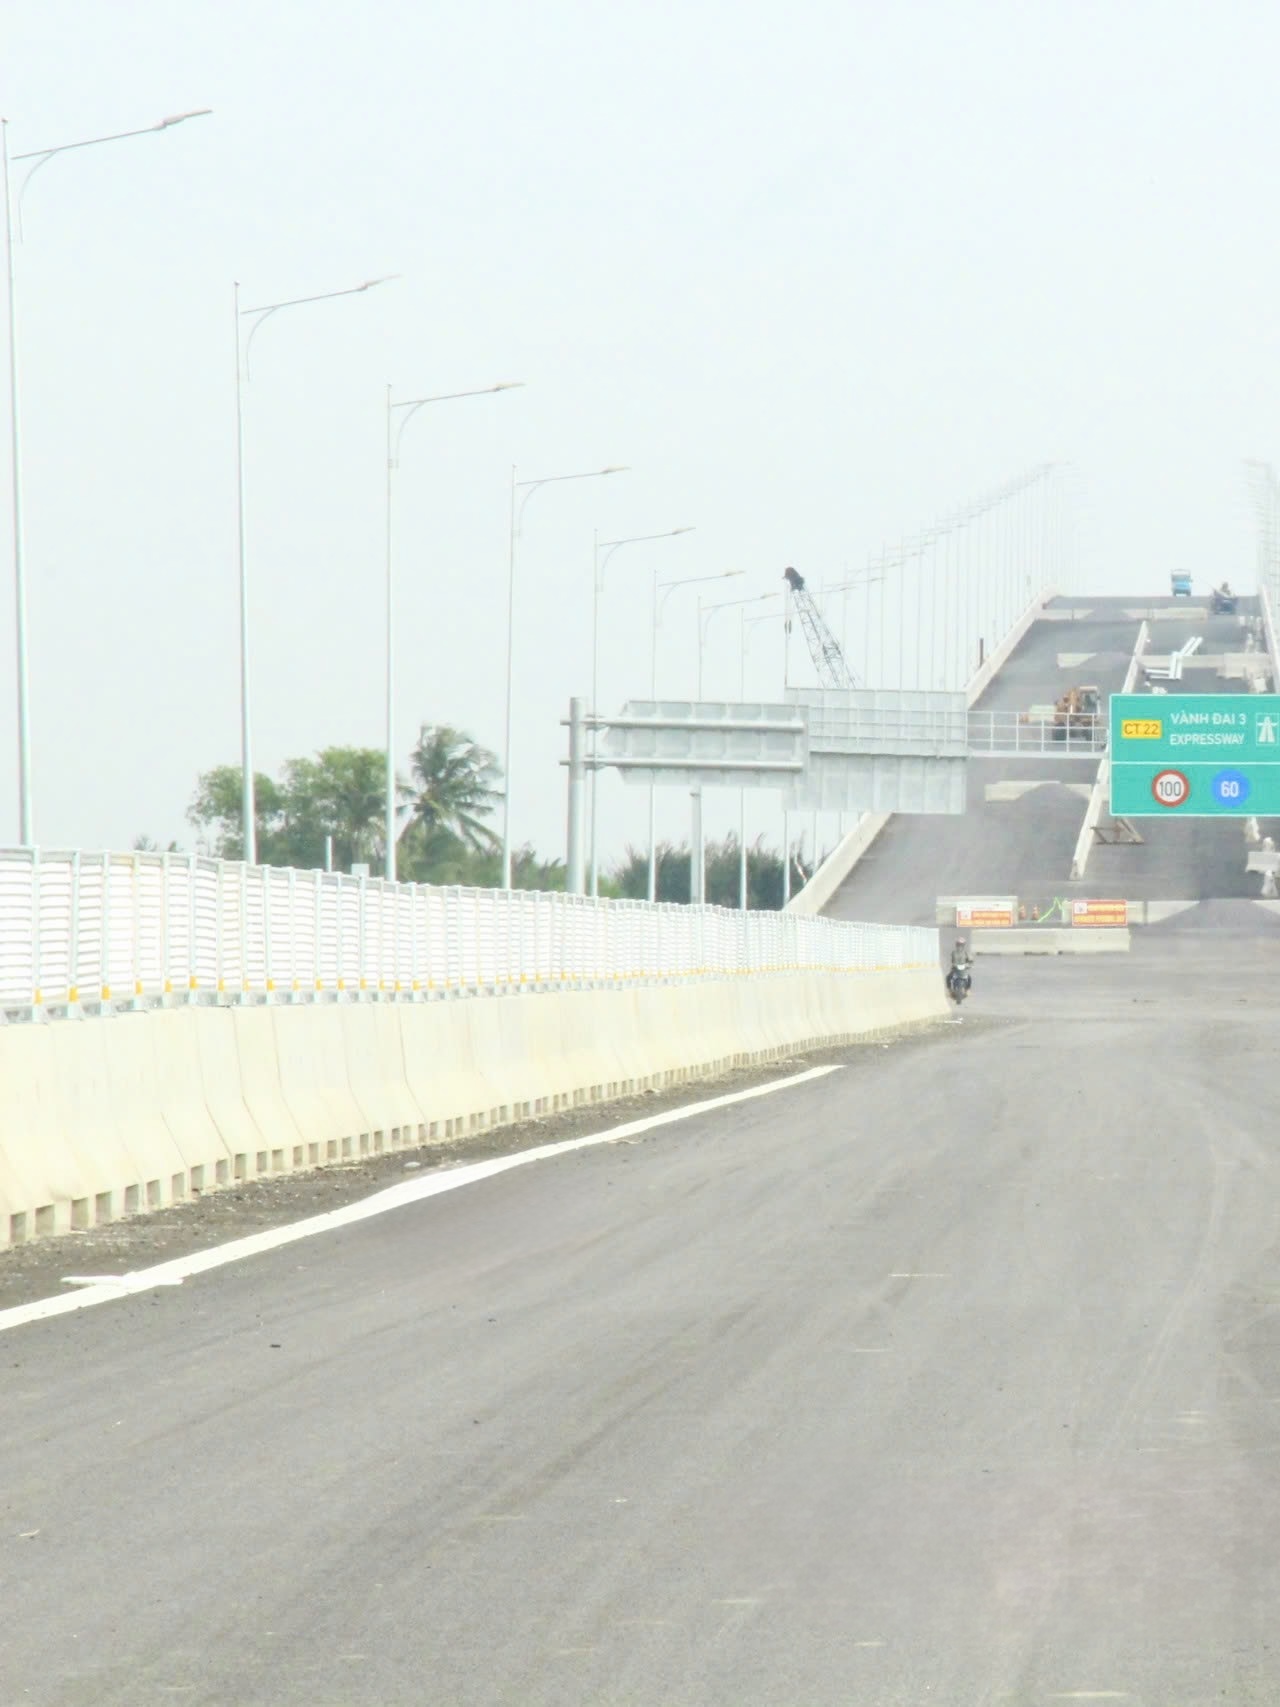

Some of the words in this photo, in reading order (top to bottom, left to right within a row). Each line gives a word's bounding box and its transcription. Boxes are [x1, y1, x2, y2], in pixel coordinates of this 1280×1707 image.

[1170, 711, 1209, 724] VÀNH
[1212, 713, 1235, 725] ĐAI
[1239, 713, 1247, 724] 3
[1170, 733, 1244, 746] EXPRESSWAY
[1159, 781, 1182, 797] 100
[1220, 781, 1239, 798] 60
